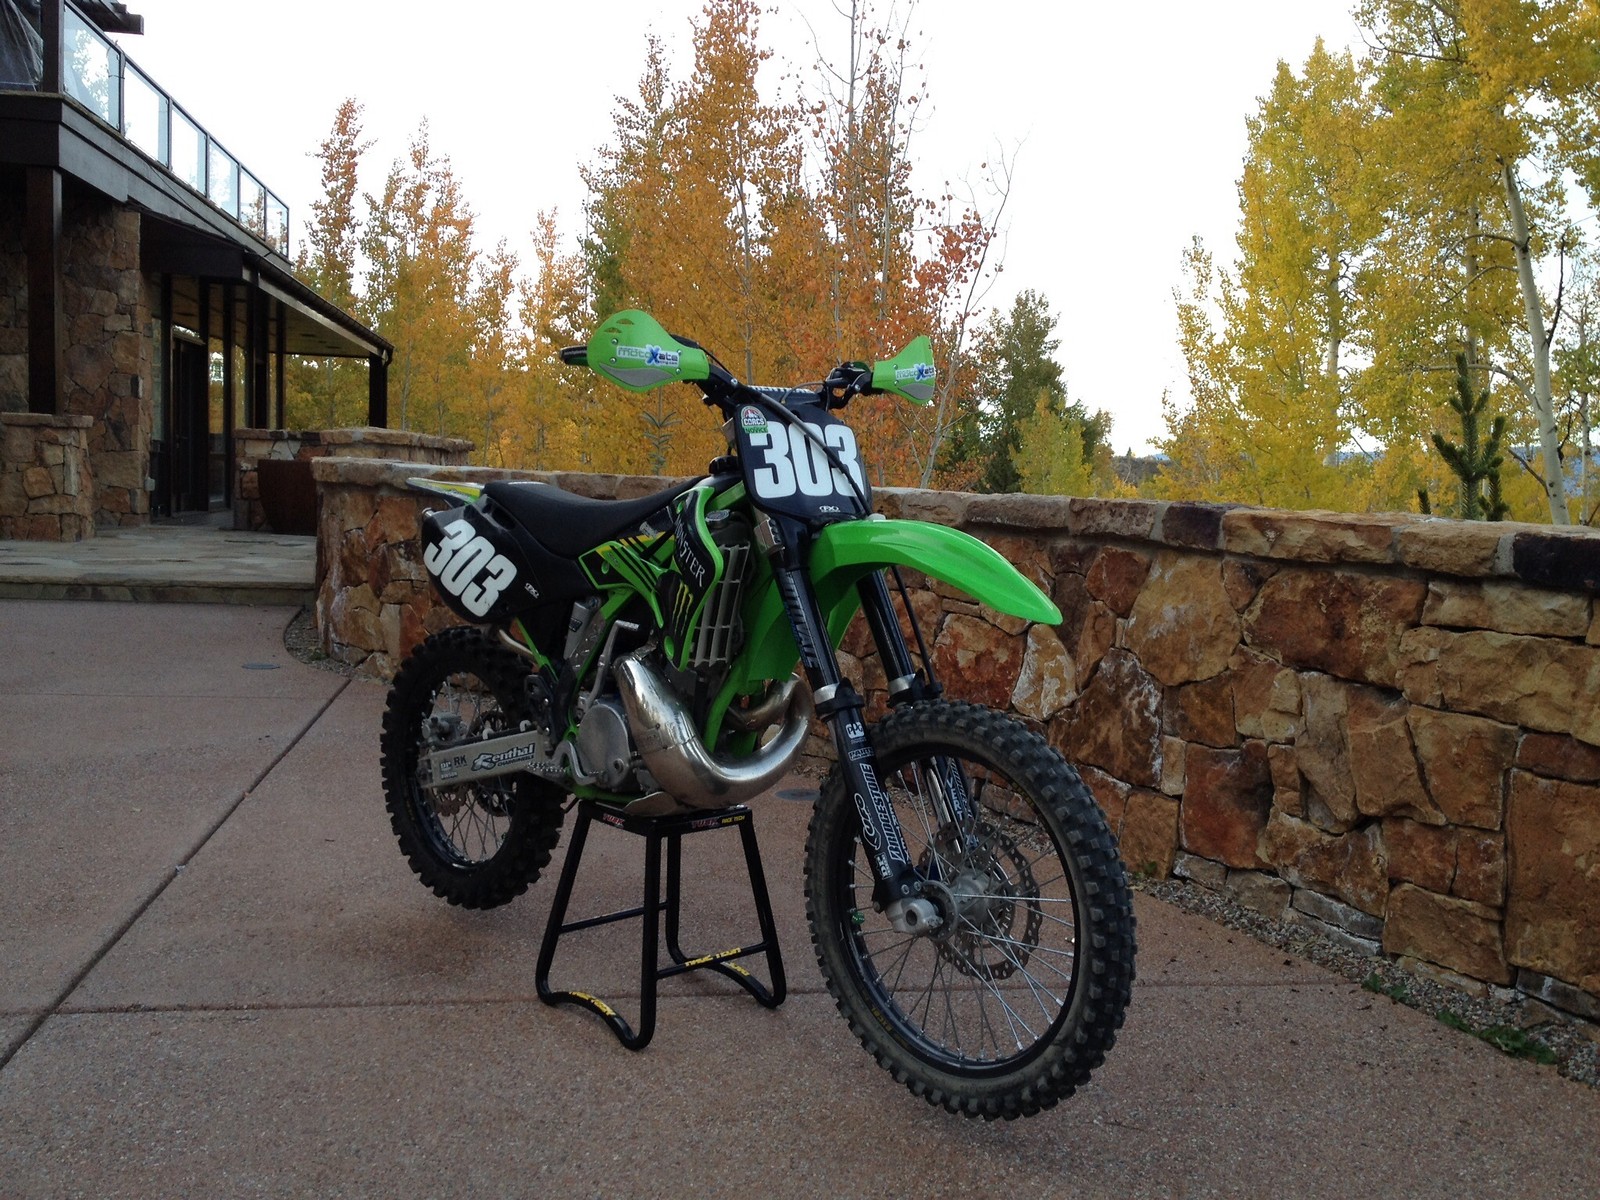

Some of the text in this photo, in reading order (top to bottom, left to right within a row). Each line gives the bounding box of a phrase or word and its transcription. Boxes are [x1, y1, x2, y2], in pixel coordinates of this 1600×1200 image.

[745, 426, 769, 434] NOVICE
[749, 420, 865, 499] 303
[423, 518, 518, 617] 303
[675, 513, 706, 587] MONSTER
[453, 755, 468, 766] RK
[471, 743, 535, 771] Renthal
[860, 763, 907, 865] BRIDGESTONE
